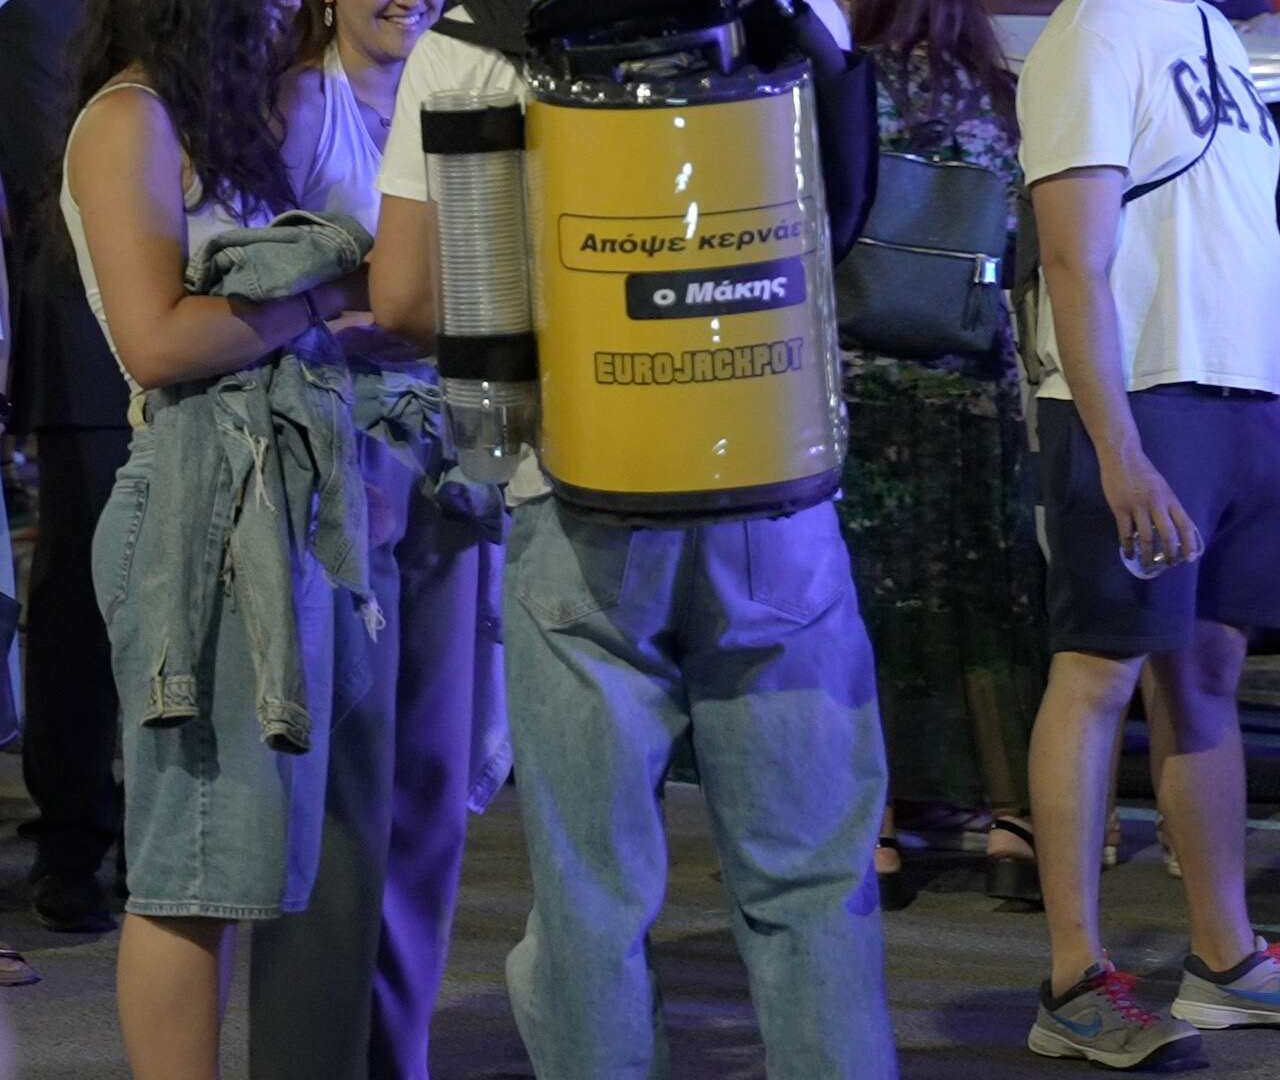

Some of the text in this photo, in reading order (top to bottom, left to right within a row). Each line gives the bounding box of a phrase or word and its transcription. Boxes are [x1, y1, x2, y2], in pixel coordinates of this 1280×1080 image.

[580, 220, 802, 258] Απόψε κερνάε
[685, 275, 788, 305] Μάκης
[594, 337, 804, 386] EUROJACKPOT
